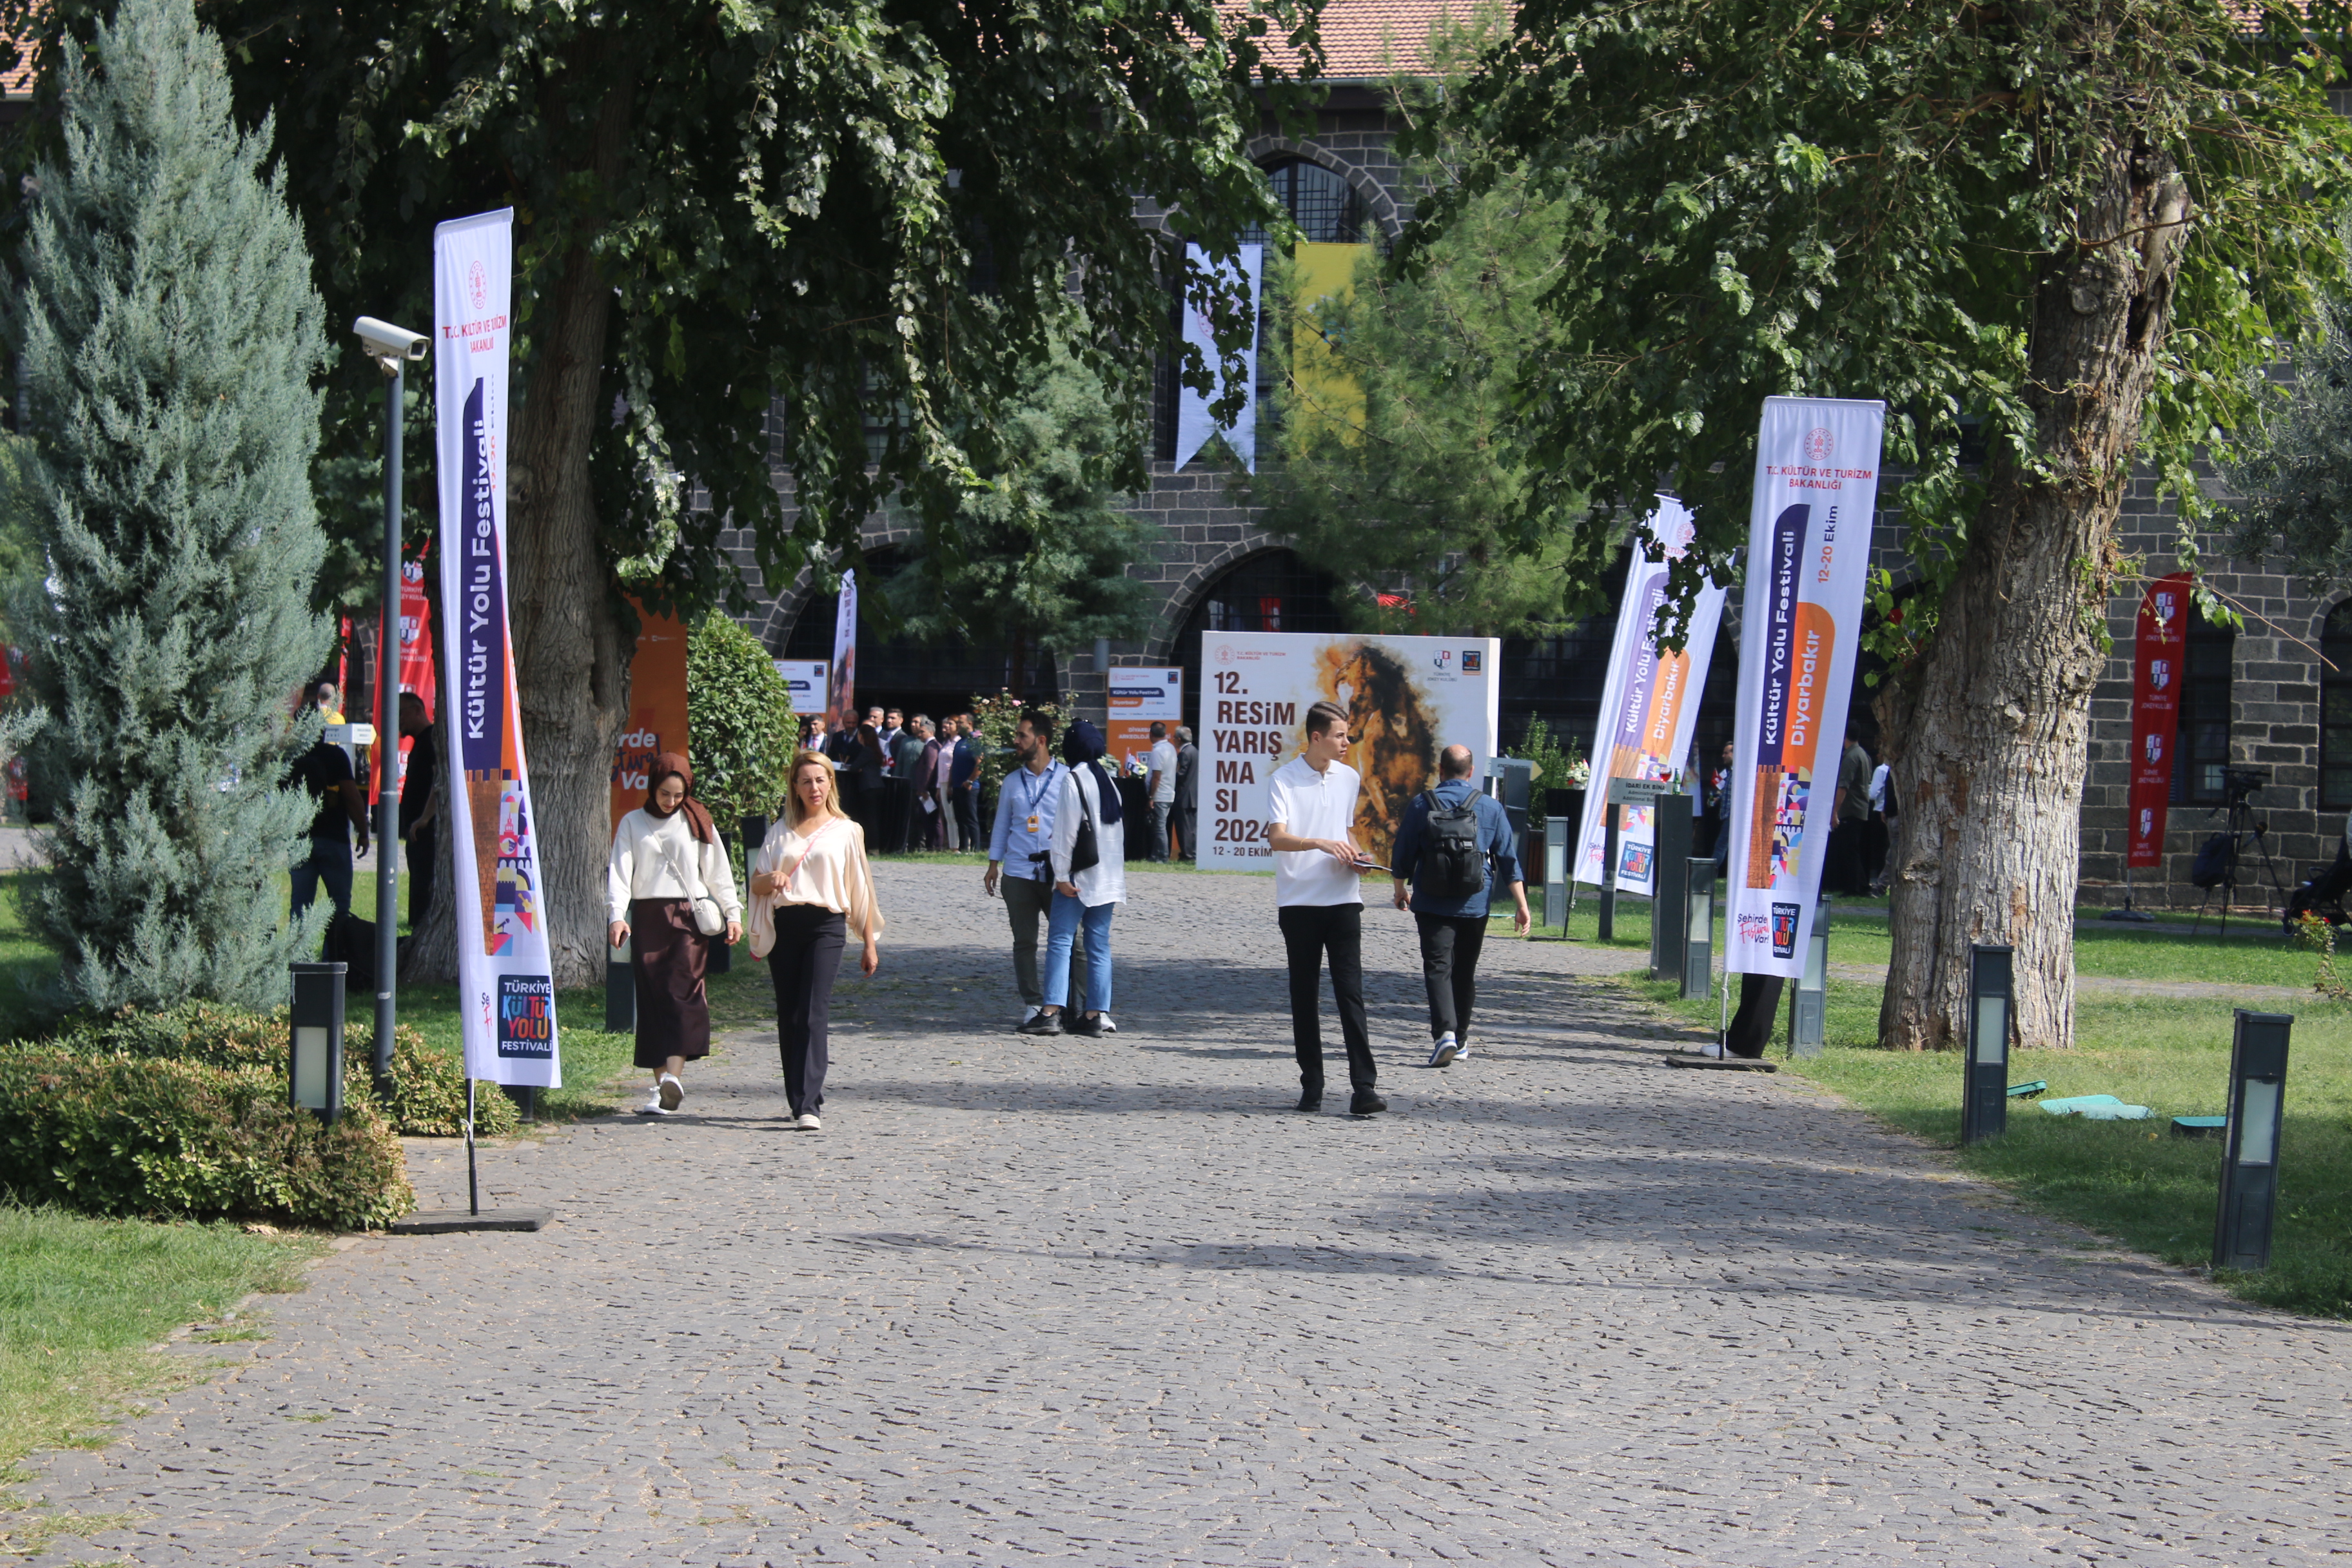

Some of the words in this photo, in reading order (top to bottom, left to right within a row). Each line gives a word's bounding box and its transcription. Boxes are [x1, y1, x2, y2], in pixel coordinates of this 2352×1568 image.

[1767, 466, 1779, 475] T.C.
[1781, 466, 1817, 476] KÜLTÜR
[1819, 469, 1832, 477] VE
[1834, 469, 1872, 480] TURİZM
[1789, 479, 1842, 490] BAKANLIĞI
[472, 420, 491, 557] Festivali
[1824, 505, 1838, 542] Ekim
[1818, 546, 1833, 583] 12-20
[1776, 531, 1795, 623] Festivali
[470, 565, 491, 634] Yolu
[1771, 628, 1787, 675] Yolu
[1634, 653, 1651, 686] Yolu
[468, 640, 488, 739] Kültür
[1215, 671, 1248, 694] 12.
[1791, 630, 1820, 747] Diyarbakır
[1625, 687, 1644, 733] Kültür
[1653, 660, 1680, 740] Diyarbakır
[1766, 678, 1782, 745] Kültür
[1213, 730, 1282, 761] YARIŞ
[1216, 760, 1255, 784] MA
[1215, 789, 1237, 812] SI
[1215, 818, 1270, 842] 2024
[1213, 846, 1224, 856] 12
[1234, 847, 1245, 856] 20
[1248, 846, 1273, 857] EKİM
[1625, 850, 1651, 865] KÜLTÜR
[1627, 843, 1652, 854] TÜRKİYE
[1621, 869, 1647, 879] FESTİVALİ
[1627, 861, 1646, 873] YOLU
[1738, 913, 1767, 925] Şehirde
[1754, 934, 1769, 944] Var!
[504, 979, 551, 994] TÜRKİYE
[503, 995, 551, 1021] KÜLTÜR
[508, 1017, 548, 1039] YOLU
[502, 1039, 553, 1052] FESTİVALİ
